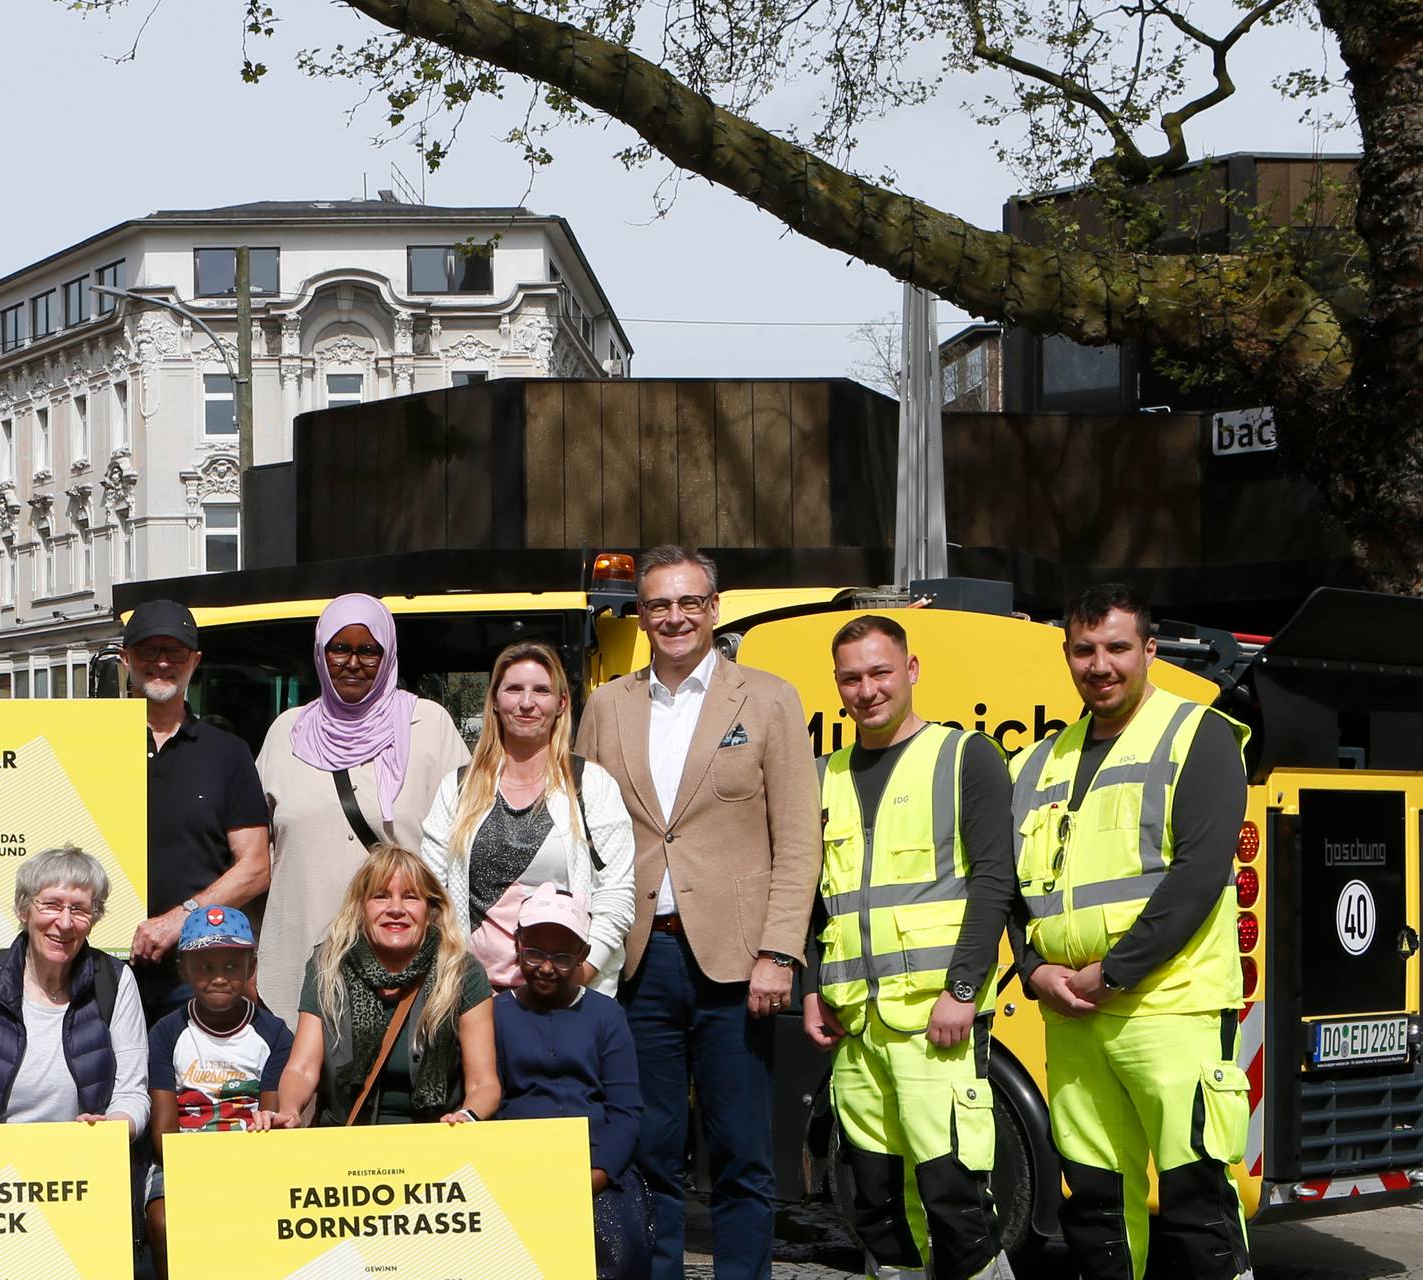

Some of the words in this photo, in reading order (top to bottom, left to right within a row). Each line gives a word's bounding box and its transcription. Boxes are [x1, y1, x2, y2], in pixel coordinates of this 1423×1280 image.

[0, 834, 26, 844] DAS
[1324, 838, 1386, 866] boschung
[1344, 894, 1368, 940] 40
[1323, 1026, 1341, 1057] DO
[1350, 1024, 1369, 1055] ED
[347, 1168, 405, 1177] PREISTRÄGERIN
[289, 1184, 395, 1209] FABIDO
[404, 1182, 467, 1205] KITA
[277, 1212, 482, 1240] BORNSTRASSE
